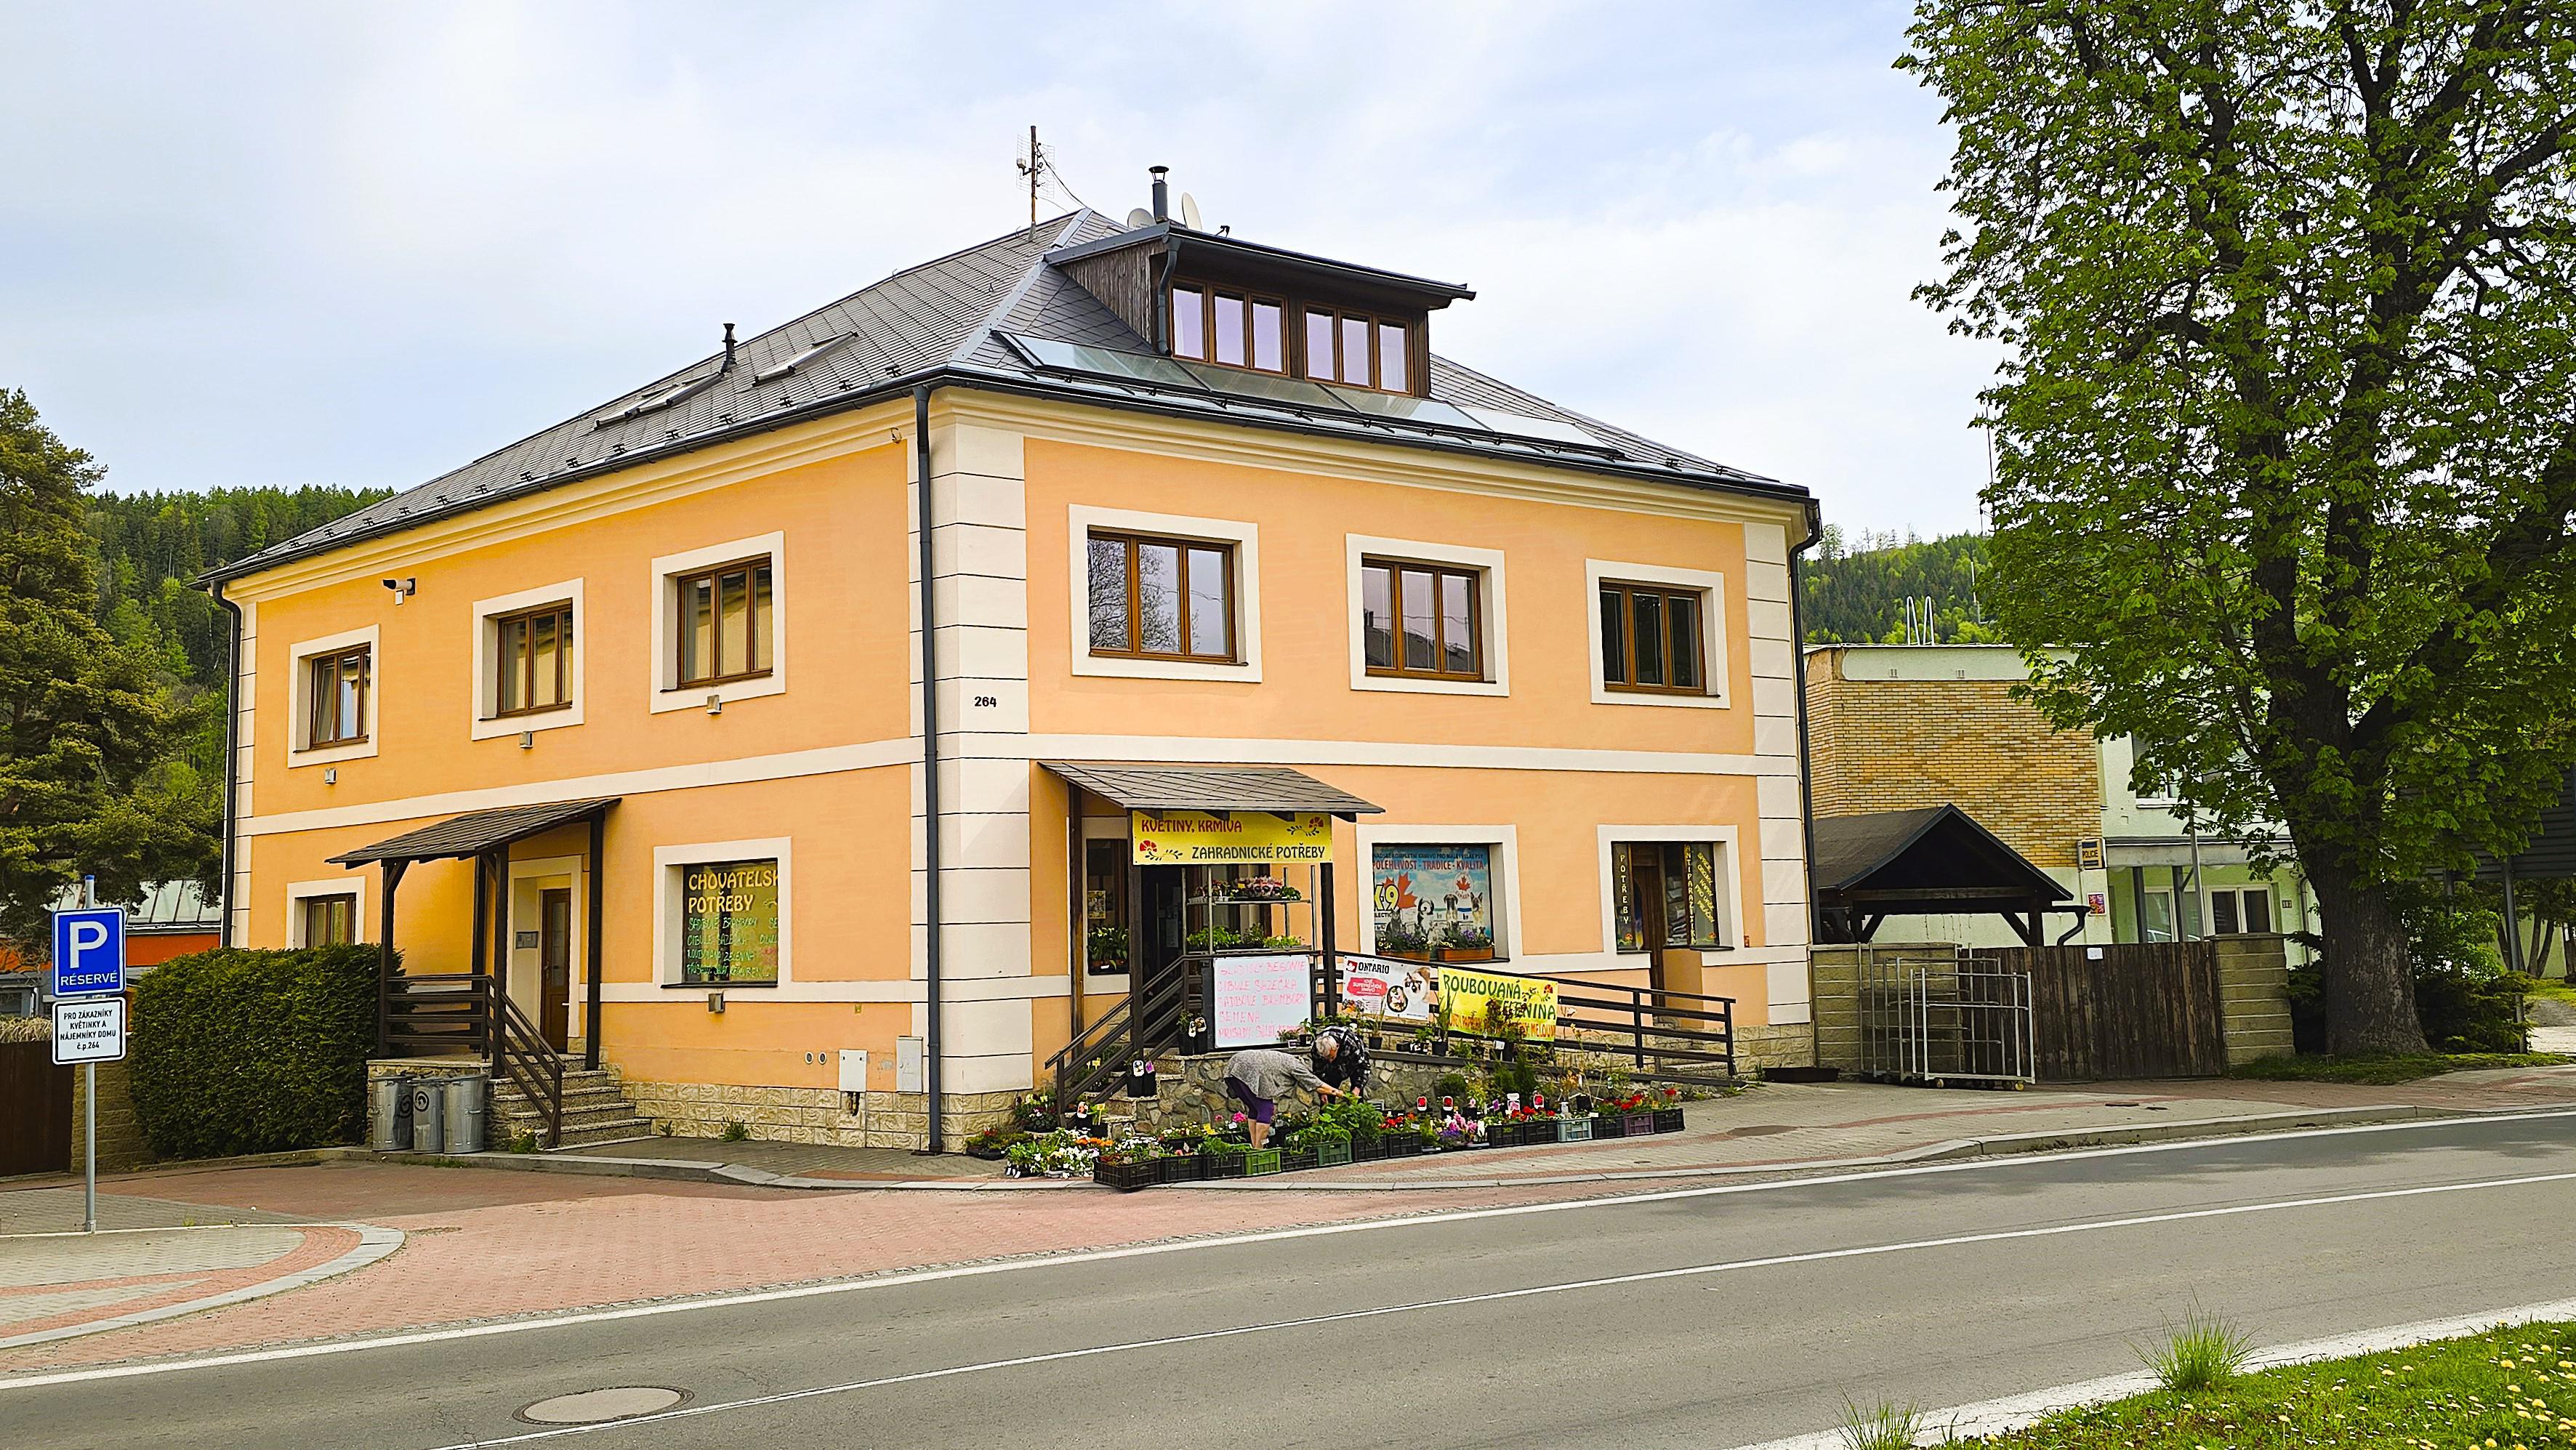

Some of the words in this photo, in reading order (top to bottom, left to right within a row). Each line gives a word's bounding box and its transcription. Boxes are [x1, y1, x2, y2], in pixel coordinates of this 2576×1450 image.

[974, 696, 997, 707] 264
[1192, 843, 1272, 859] ZAHRADNICKÉ
[1276, 843, 1325, 858] POTŘEBY
[1423, 861, 1451, 870] TRADICE
[1457, 861, 1484, 870] KVALITA
[1620, 854, 1629, 924] POTŘEBY
[688, 891, 754, 913] POTŘEBY
[70, 921, 108, 968] P
[1358, 962, 1390, 975] ONTARIO
[60, 970, 118, 986] RÉSERVÉ
[1443, 974, 1521, 999] ROUBOVANÁ
[79, 1008, 113, 1019] ZÁKAZNÍKY
[1219, 1011, 1260, 1023] SEMENA
[70, 1020, 100, 1030] KVĚTINKY
[60, 1031, 97, 1041] NÁJEMNÍKY
